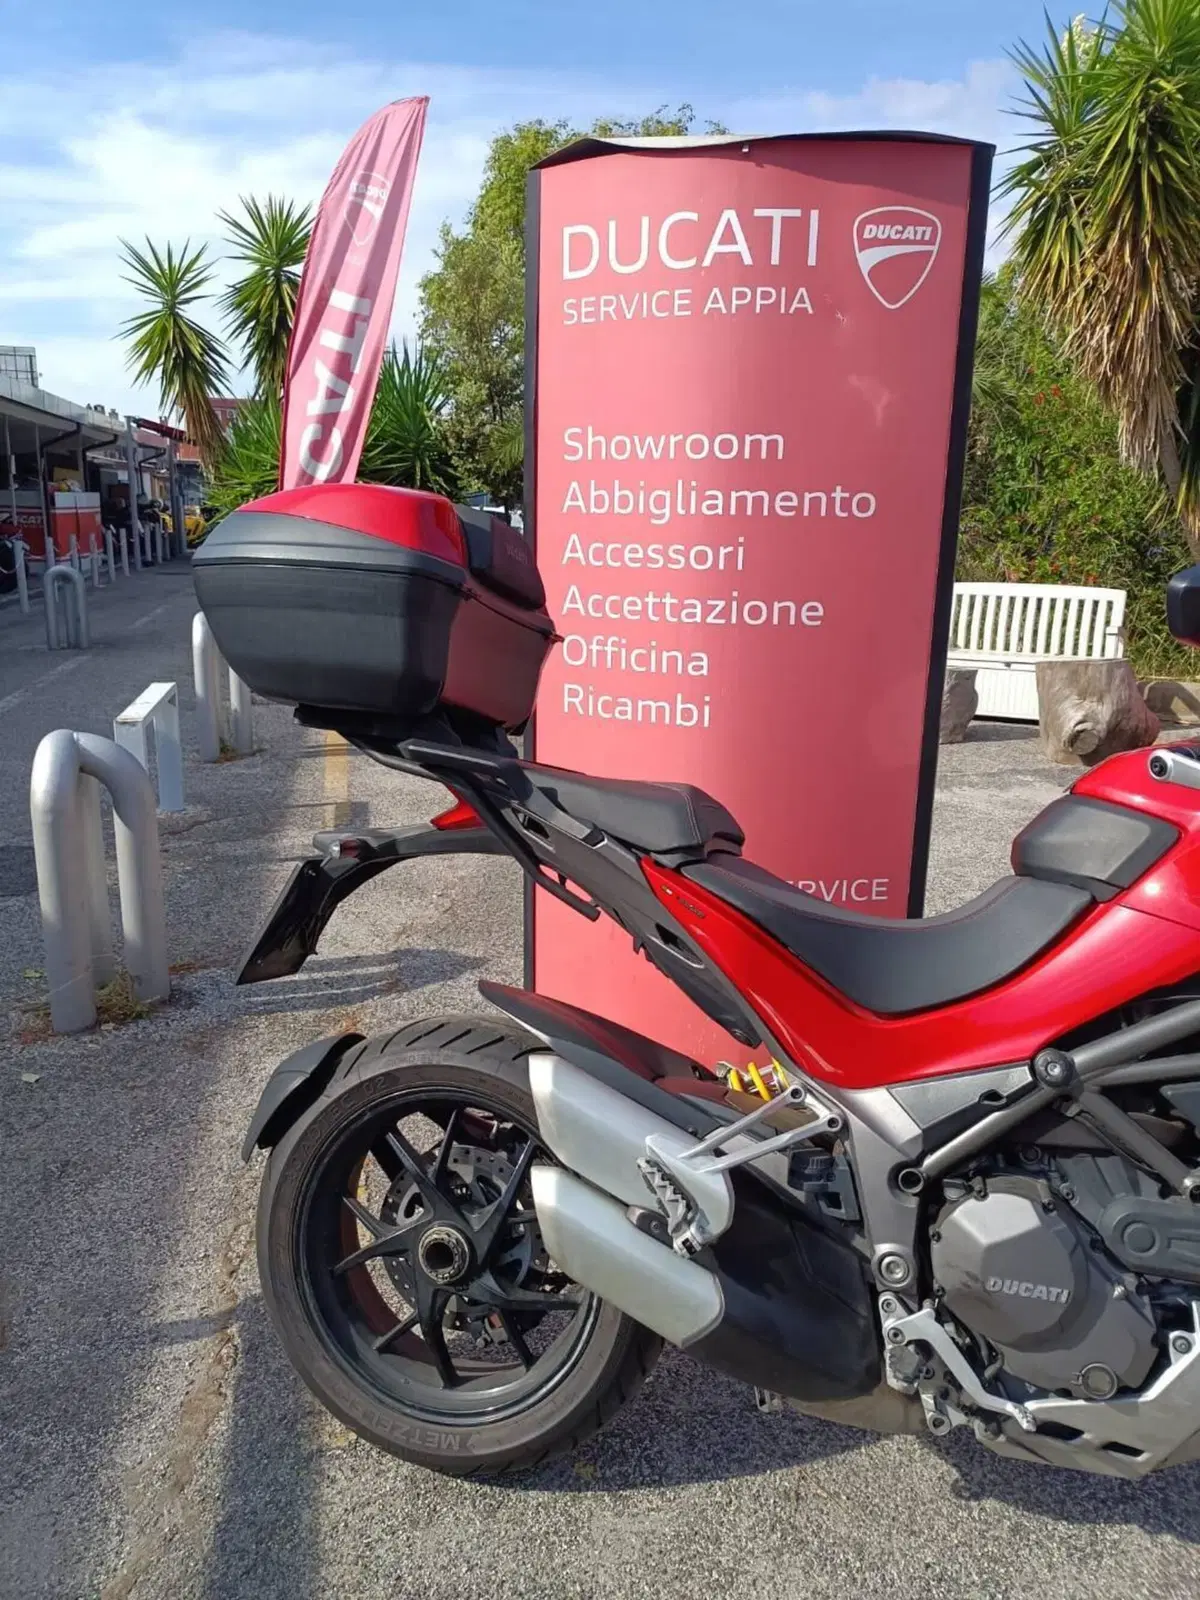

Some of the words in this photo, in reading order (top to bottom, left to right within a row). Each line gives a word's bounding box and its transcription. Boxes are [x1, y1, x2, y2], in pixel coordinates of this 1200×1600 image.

[562, 208, 820, 281] DUCATI
[863, 224, 933, 241] DUCATI
[563, 288, 692, 325] SERVICE
[703, 286, 814, 316] APPIA
[563, 425, 784, 462] Showroom
[562, 479, 877, 525] Abbigliamento
[562, 533, 745, 570] Accessori
[562, 585, 825, 626] Accettazione
[562, 633, 709, 676] Officina
[563, 682, 711, 728] Ricambi
[785, 878, 890, 902] RVICE
[985, 1276, 1071, 1304] DUCATI
